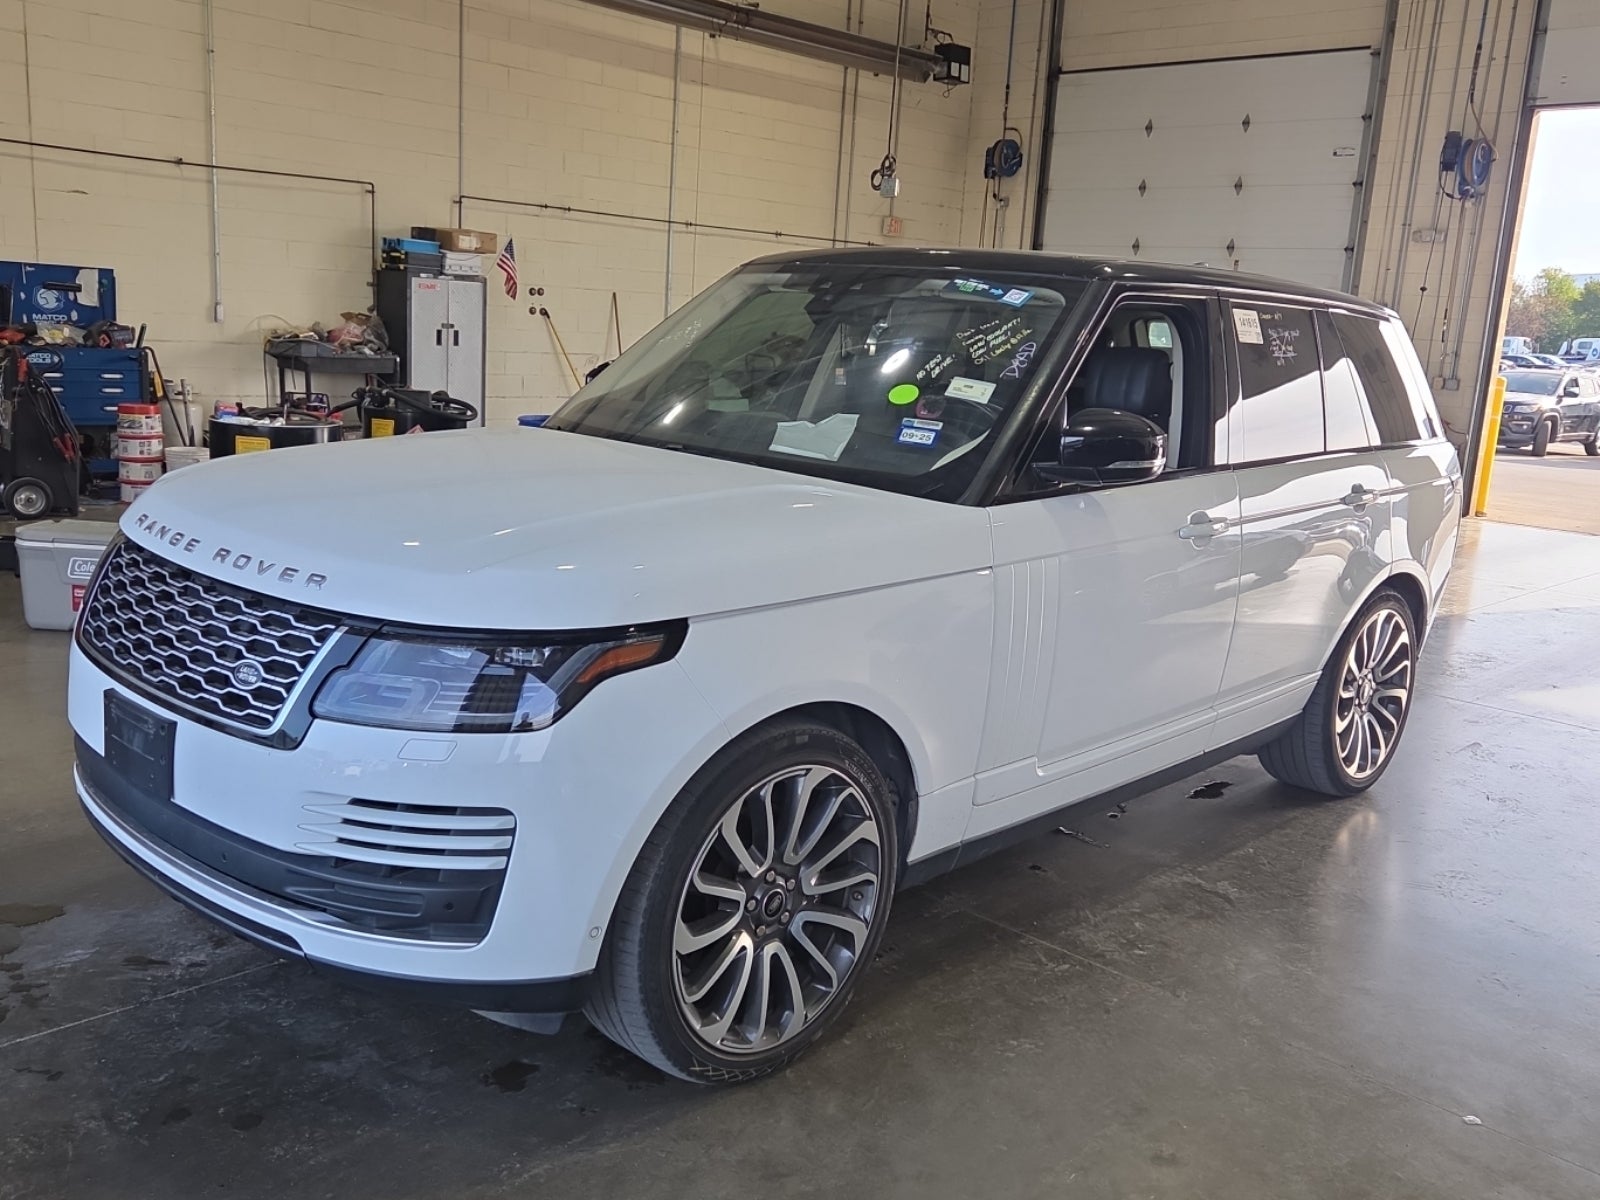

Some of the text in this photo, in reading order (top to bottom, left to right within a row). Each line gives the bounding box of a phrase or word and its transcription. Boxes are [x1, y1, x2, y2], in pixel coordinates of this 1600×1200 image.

[32, 313, 68, 321] MATCO
[134, 513, 328, 591] RANGE ROVER
[75, 560, 96, 572] Cole
